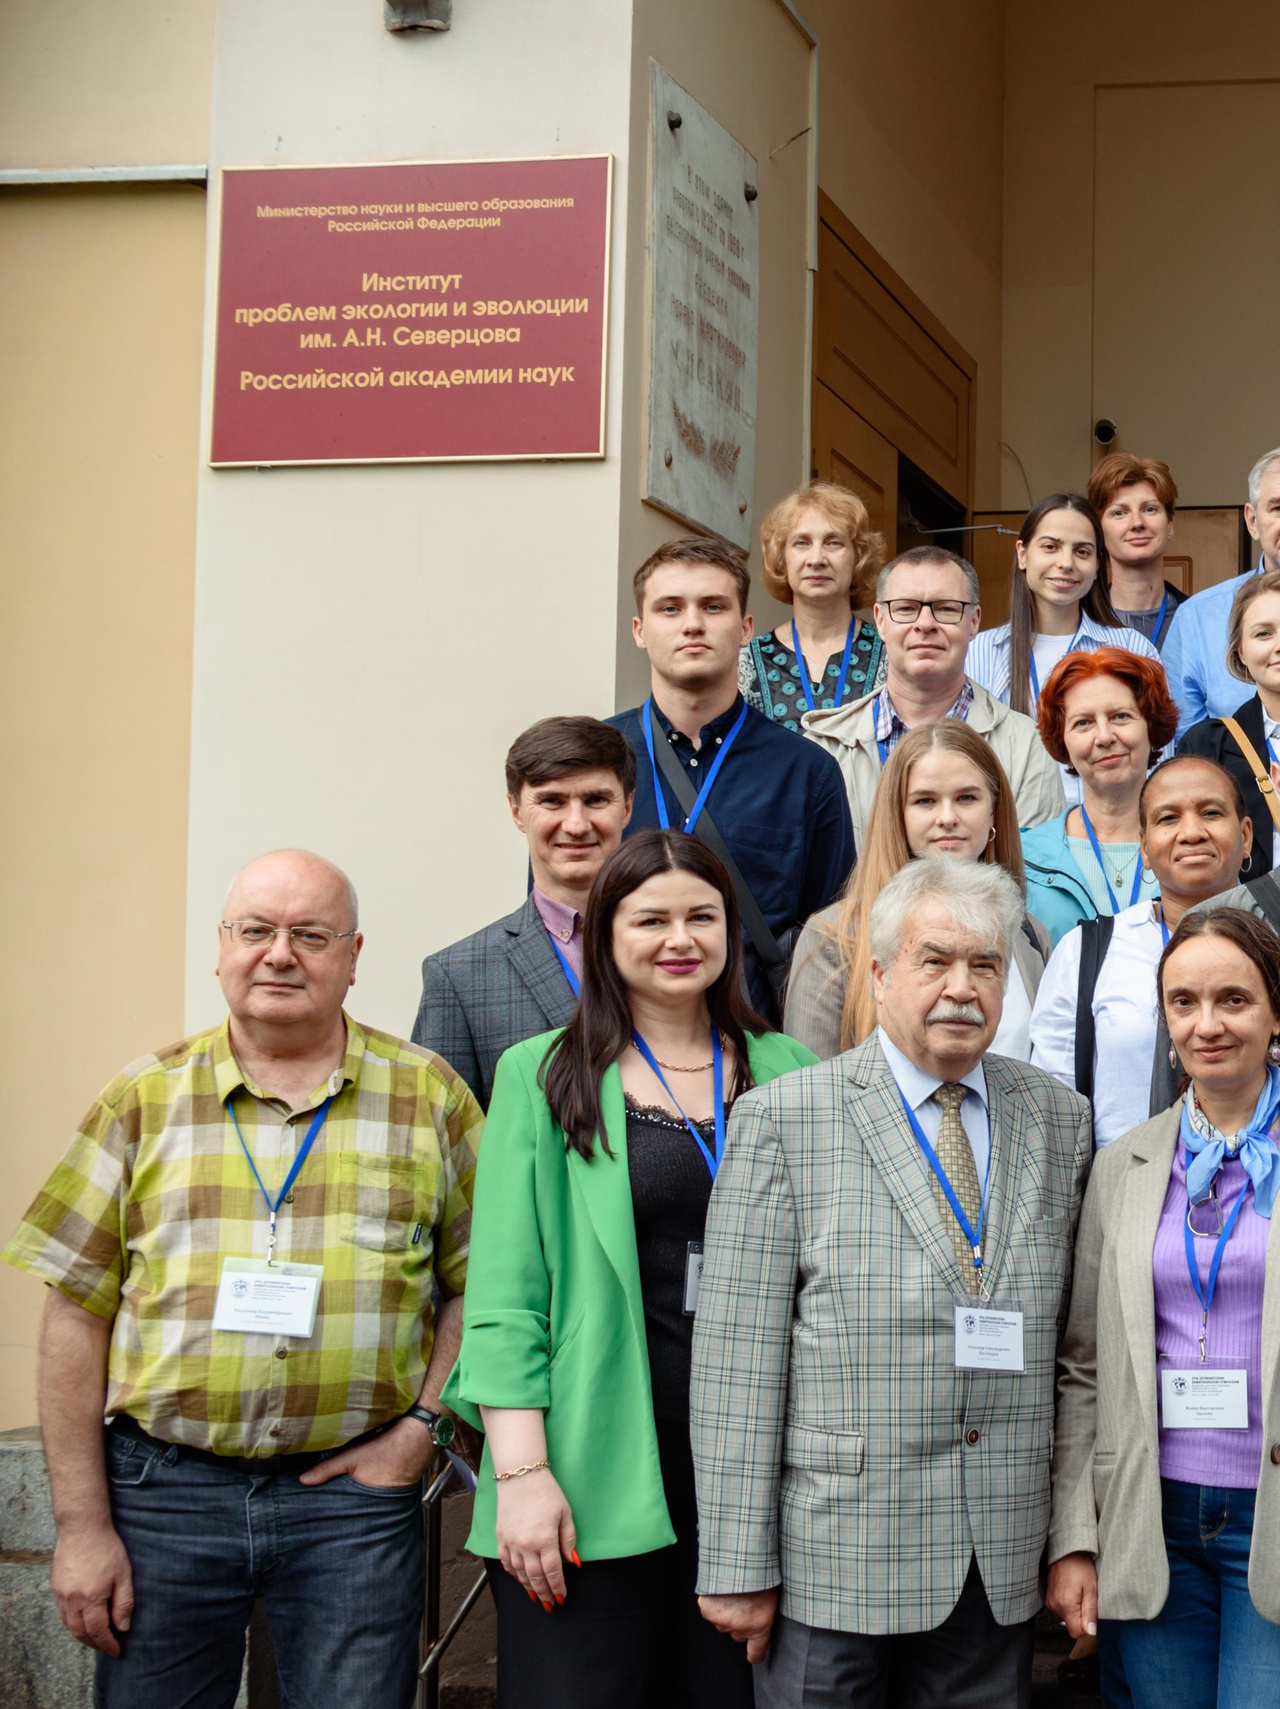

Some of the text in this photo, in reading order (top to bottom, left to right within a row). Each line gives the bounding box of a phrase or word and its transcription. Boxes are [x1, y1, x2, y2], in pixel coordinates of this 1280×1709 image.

[256, 197, 575, 219] Министерство науки и высшего образования
[327, 216, 501, 233] Российской Федерации
[362, 272, 463, 294] Институт
[235, 297, 589, 328] проблем экологии и эволюции
[299, 326, 521, 349] им. А.Н. Северцова
[240, 366, 575, 391] Российской академии наук
